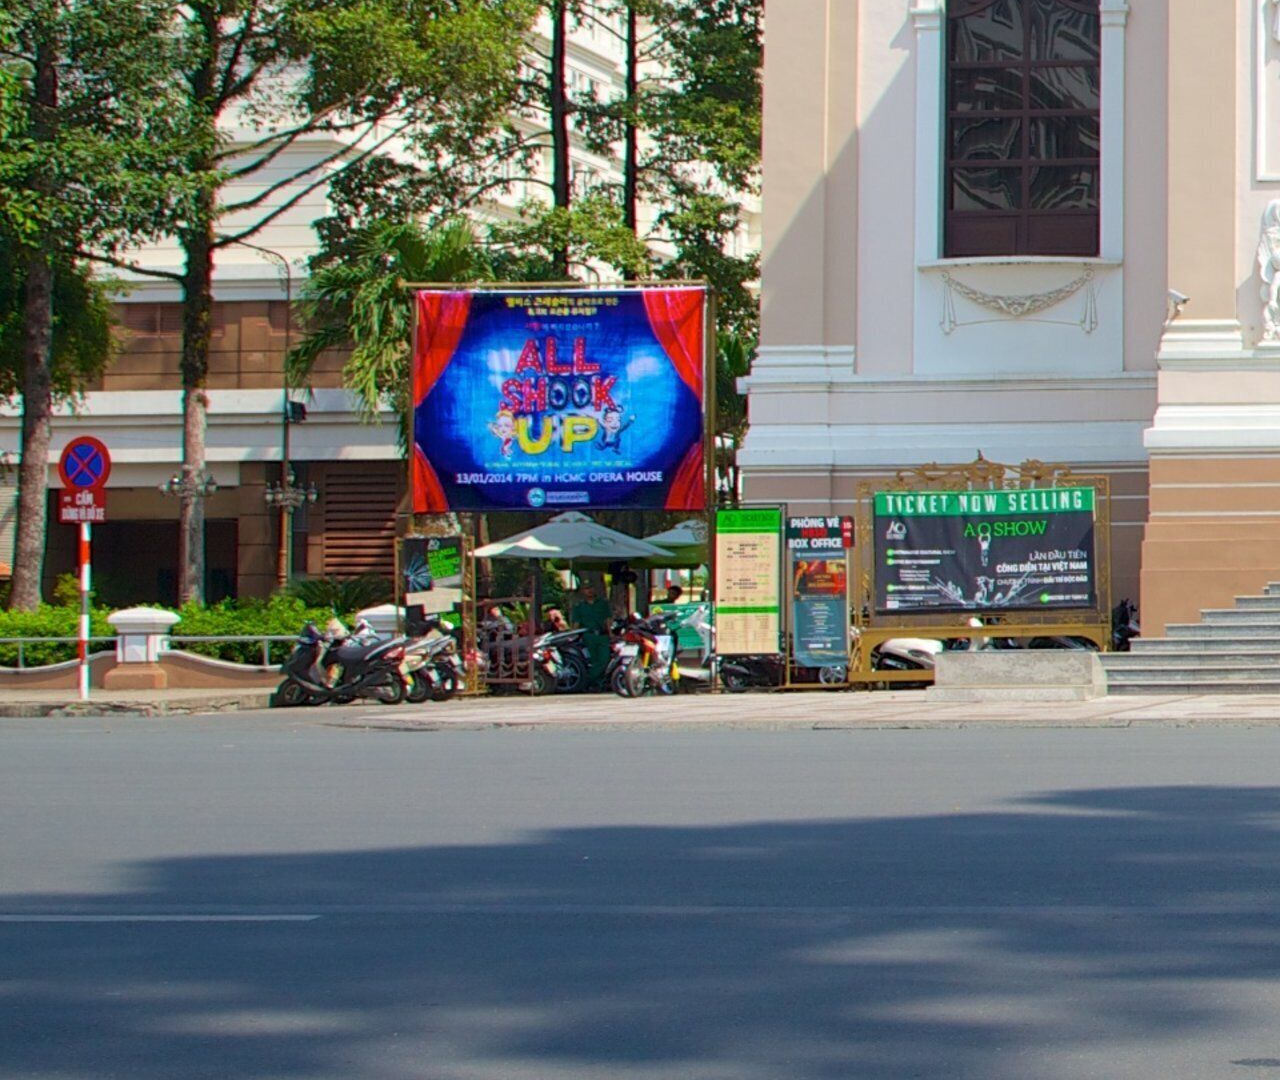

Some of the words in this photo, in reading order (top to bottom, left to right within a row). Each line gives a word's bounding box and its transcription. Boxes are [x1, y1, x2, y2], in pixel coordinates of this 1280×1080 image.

[515, 337, 600, 375] ALL
[500, 374, 617, 413] SHOOK
[517, 416, 599, 456] UP
[456, 472, 513, 484] 13/01/2014
[516, 472, 538, 483] 7PM
[541, 473, 551, 483] in
[554, 472, 586, 482] HCMC
[588, 471, 624, 482] OPERA
[626, 471, 663, 482] HOUSE
[886, 495, 947, 513] TICKET
[960, 495, 996, 512] NOW
[1008, 491, 1082, 511] SELLING
[791, 516, 825, 528] PHÒNG
[826, 515, 840, 528] VÉ
[788, 539, 809, 549] BOX
[810, 538, 842, 548] OFFICE
[1069, 561, 1088, 570] NAM
